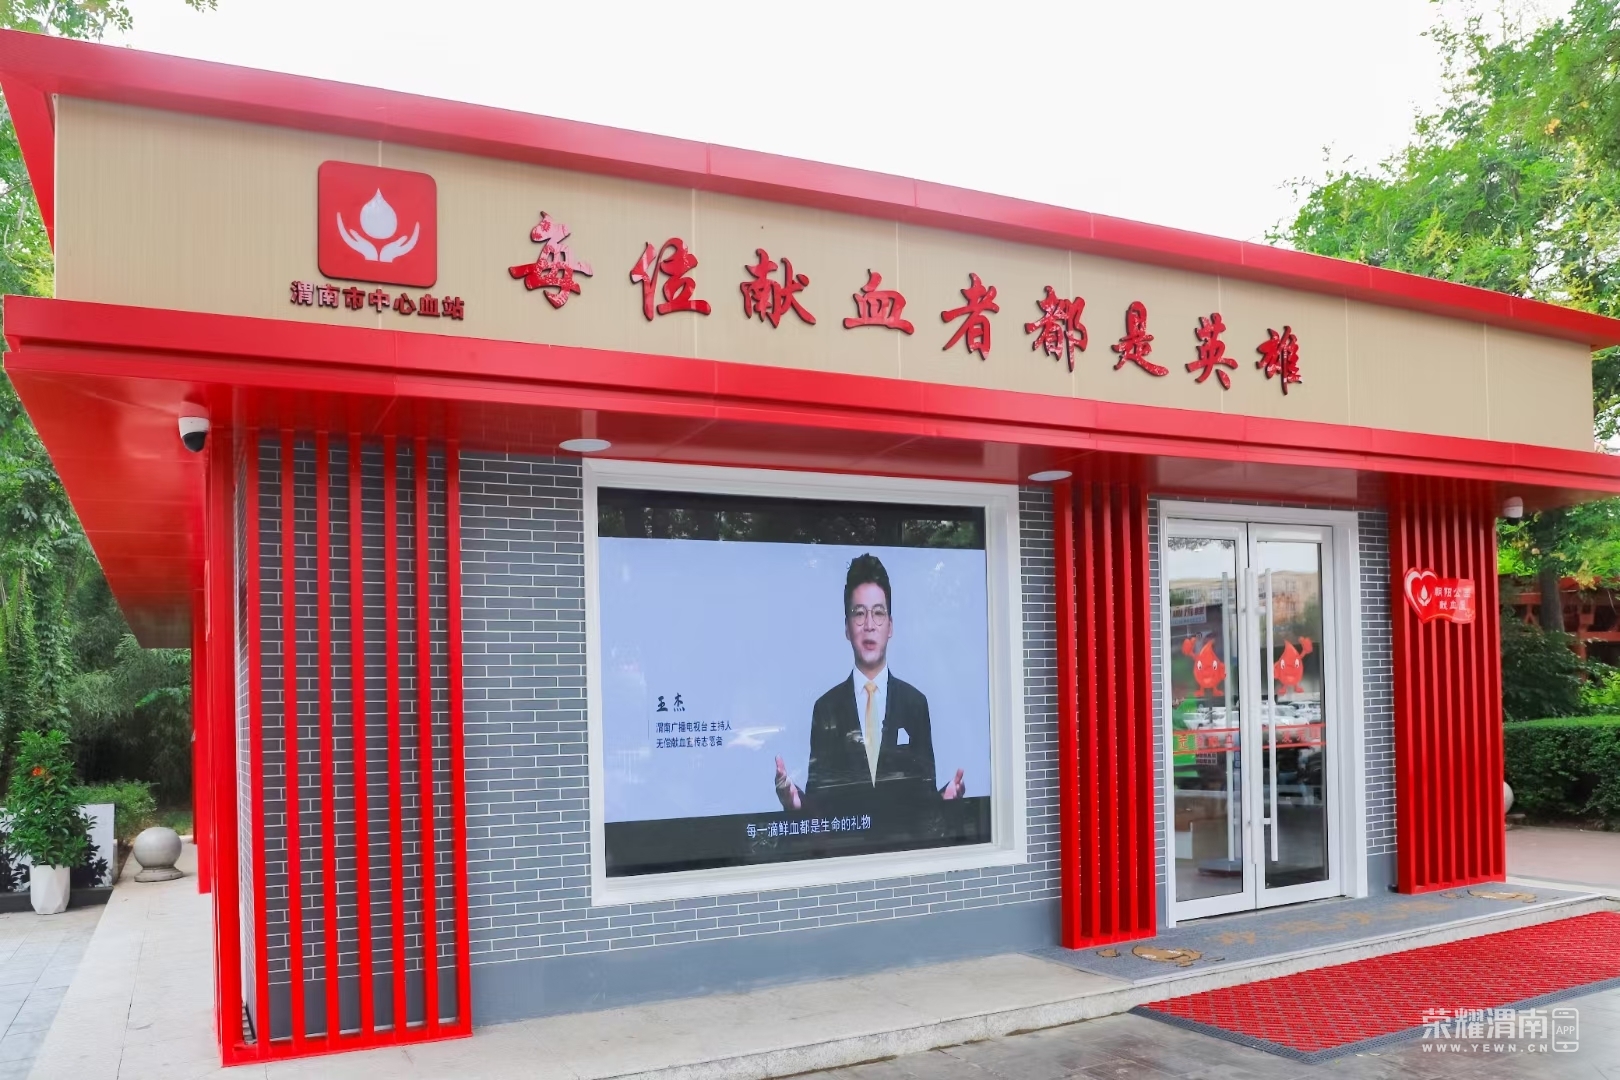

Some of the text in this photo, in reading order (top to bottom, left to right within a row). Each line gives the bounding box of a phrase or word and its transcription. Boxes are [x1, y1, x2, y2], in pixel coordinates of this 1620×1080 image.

[290, 280, 465, 320] 渭南市中心血站
[656, 720, 732, 733] 渭南广播电视台 主持人
[656, 736, 723, 749] 无偿献血宣传志愿者
[746, 814, 872, 839] 每一滴鲜血都是生命的礼物
